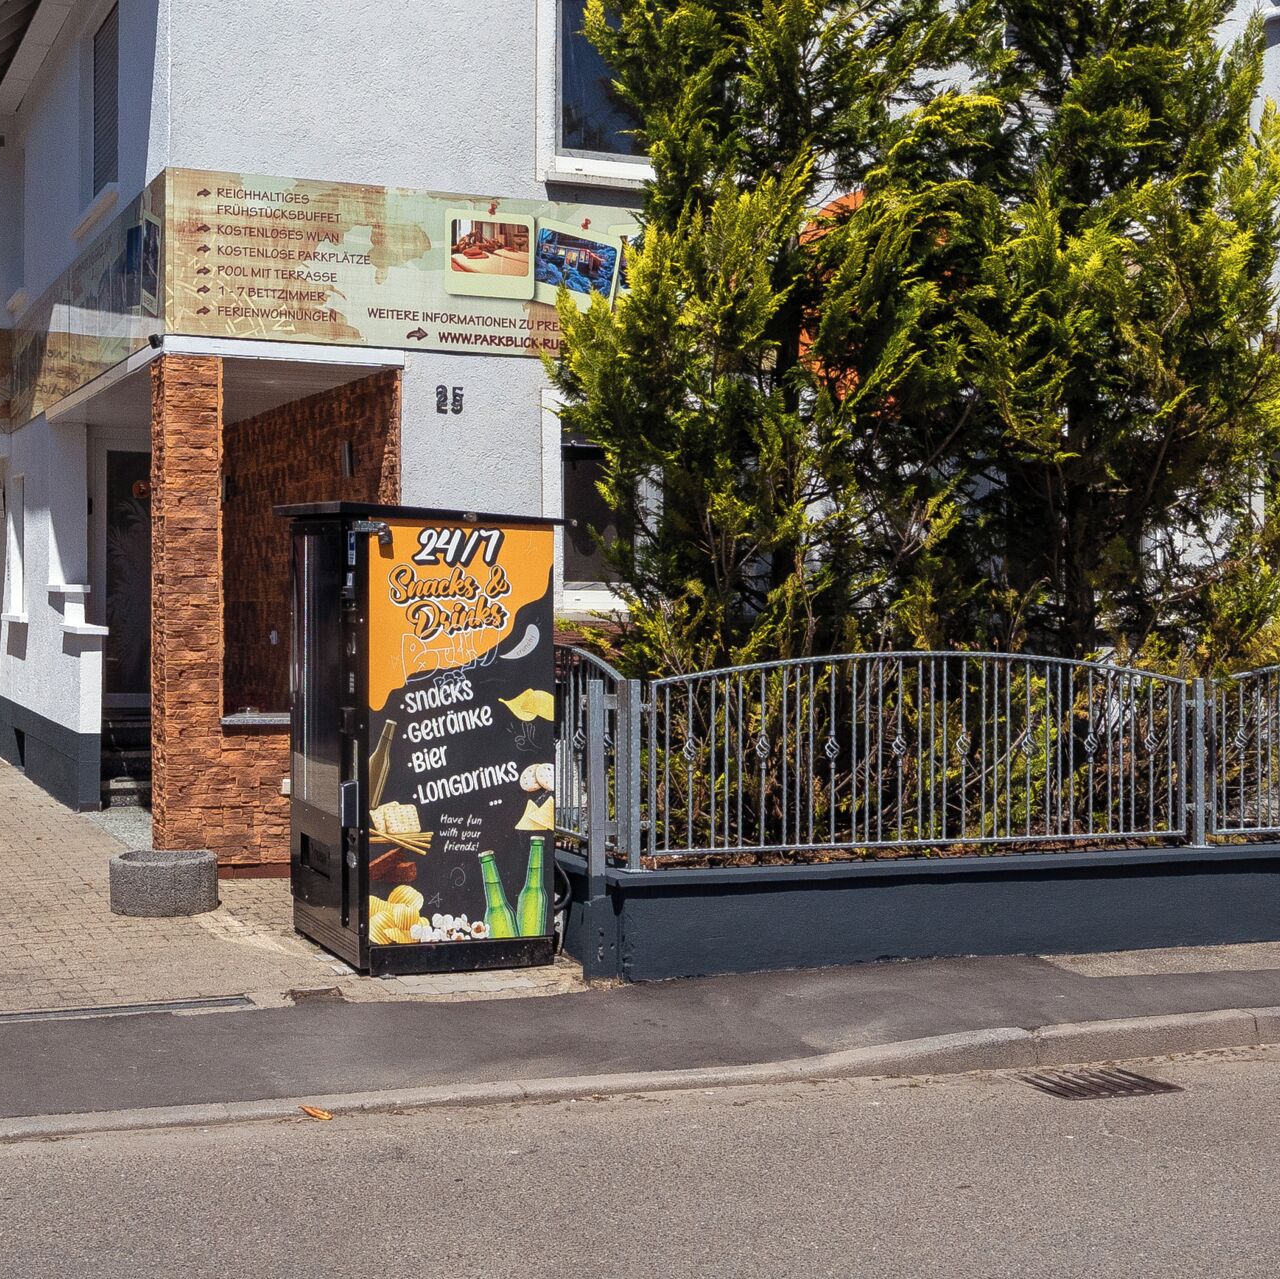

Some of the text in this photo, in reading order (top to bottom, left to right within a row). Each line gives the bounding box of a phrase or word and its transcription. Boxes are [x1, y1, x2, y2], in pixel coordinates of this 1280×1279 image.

[217, 187, 310, 204] REICHHALTIGES
[217, 204, 341, 223] FRÜHSTÜCKSBUFFET
[217, 225, 339, 243] KOSTENLOSES WLAN
[217, 245, 371, 265] KOSTENLOSE PARKPLÄTZE
[217, 265, 337, 282] POOL MIT TERRASSE
[248, 287, 326, 302] BETTZIMMER
[217, 306, 337, 322] FERIENWOHNUNGEN
[367, 307, 563, 332] WEITERE INFORMATIONEN ZU PRE
[413, 528, 503, 566] 24/7
[388, 564, 512, 606] Snacks &
[406, 596, 509, 640] Drinks
[412, 745, 447, 773] Bier
[440, 814, 483, 827] Have fun
[439, 828, 481, 841] with your
[443, 840, 480, 853] friends!
